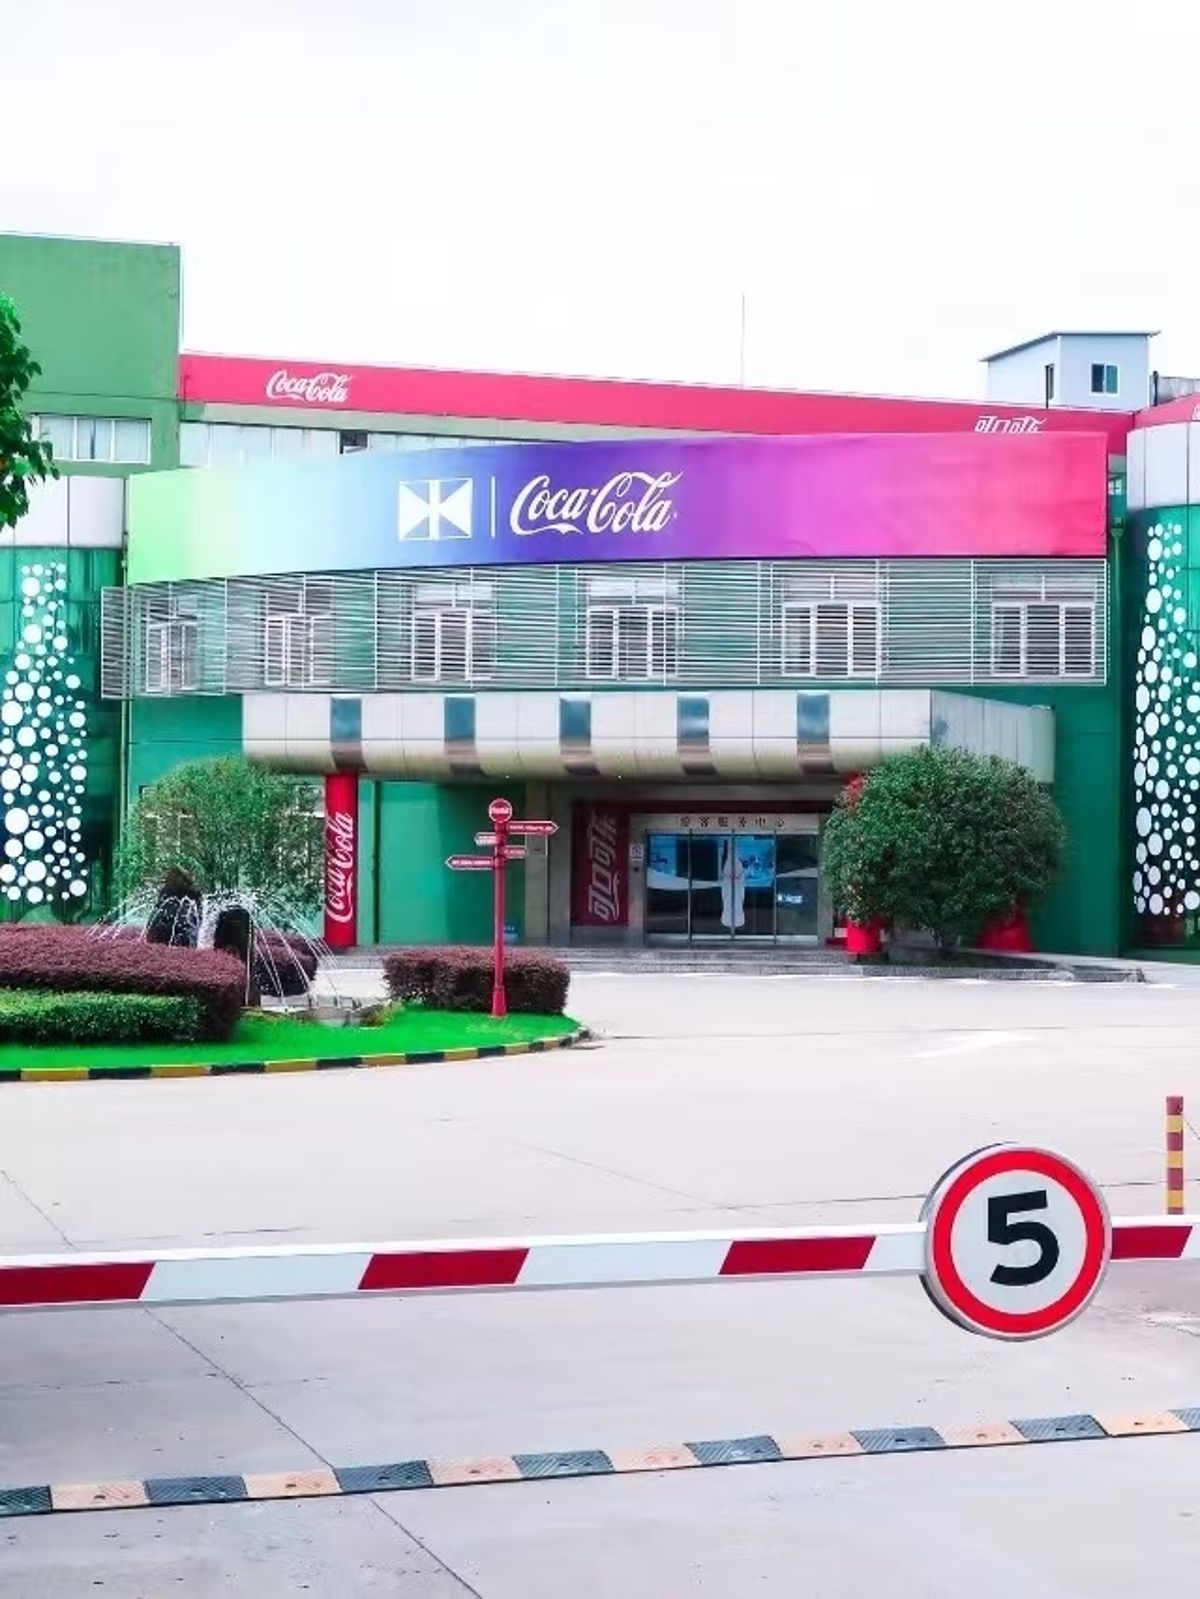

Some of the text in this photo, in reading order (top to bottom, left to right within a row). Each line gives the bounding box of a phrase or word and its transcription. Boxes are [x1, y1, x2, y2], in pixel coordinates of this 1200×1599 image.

[510, 470, 684, 535] Coca-Cola
[587, 812, 620, 921] 可口可乐
[987, 1189, 1060, 1287] 5
